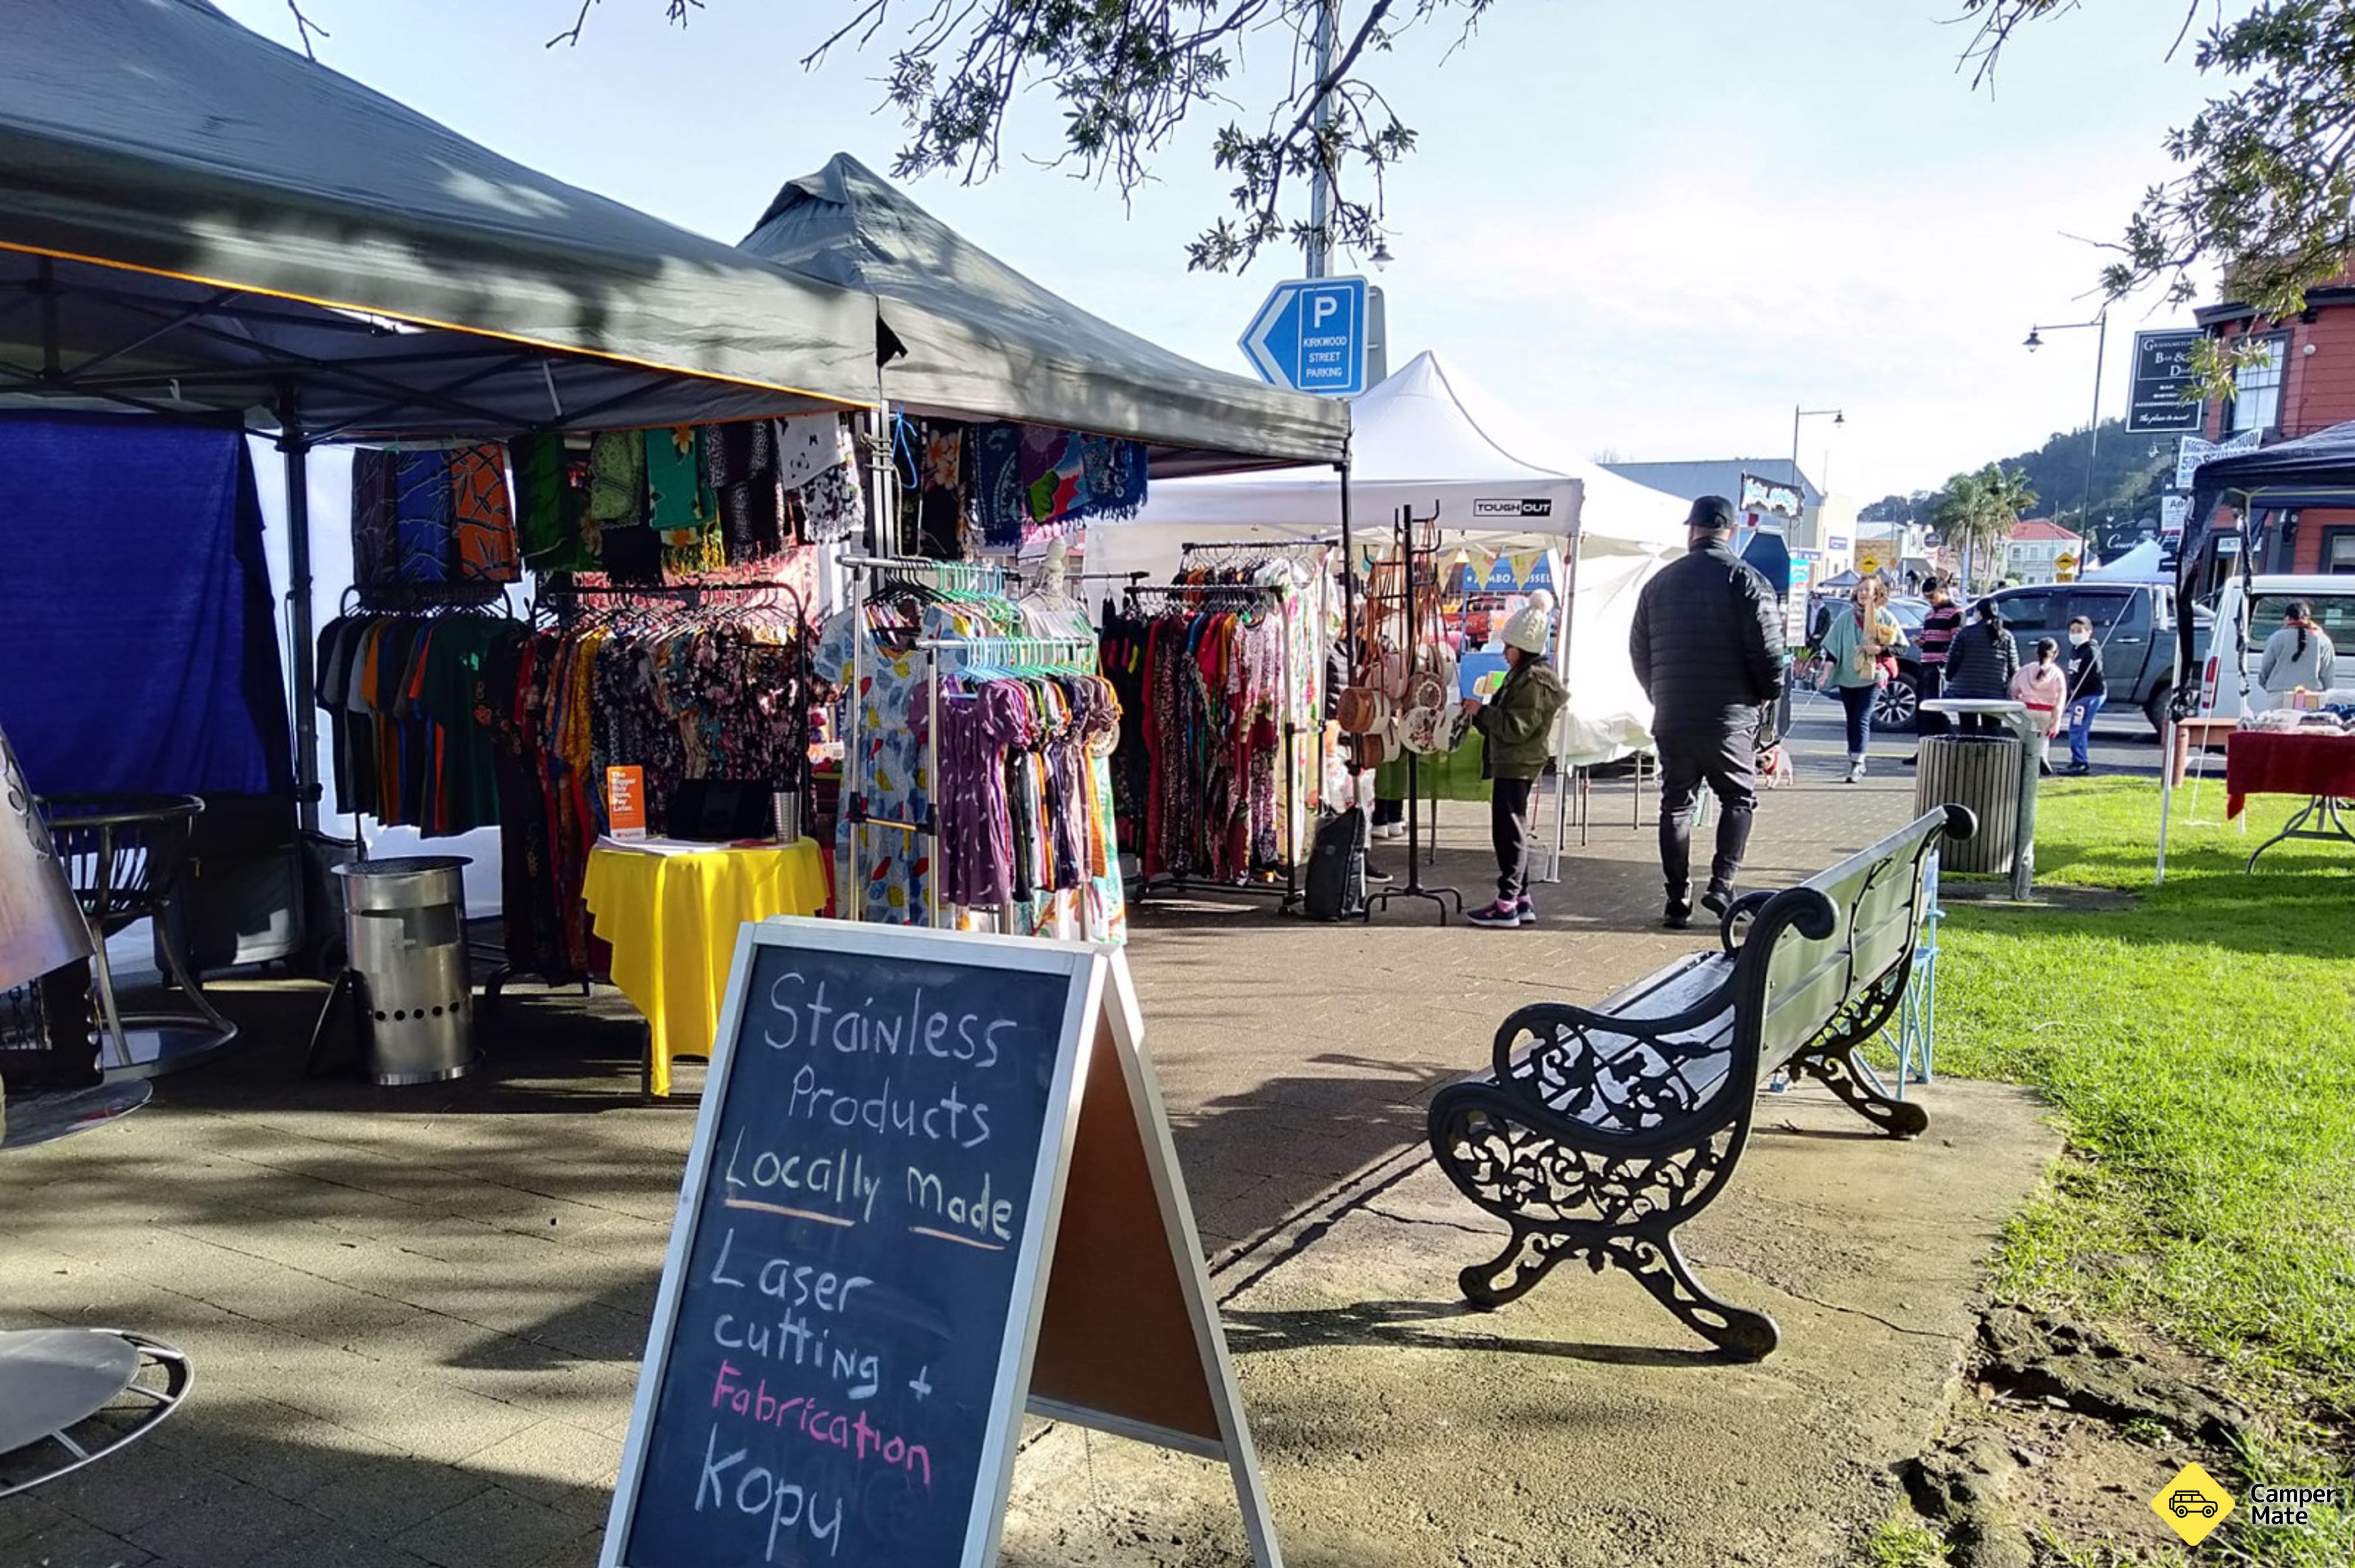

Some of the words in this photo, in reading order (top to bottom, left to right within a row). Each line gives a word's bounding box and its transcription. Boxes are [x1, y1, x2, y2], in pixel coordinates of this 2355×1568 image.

[1303, 336, 1348, 348] KIRKWOOD
[1314, 296, 1338, 328] P
[1306, 367, 1342, 378] PARKING
[1309, 351, 1341, 363] STREET
[765, 973, 1018, 1068] Stainless
[788, 1064, 990, 1149] Products
[725, 1126, 881, 1224] Locally
[711, 1227, 875, 1313] Laser
[712, 1360, 931, 1486] Fabrication
[695, 1422, 843, 1562] Kopu
